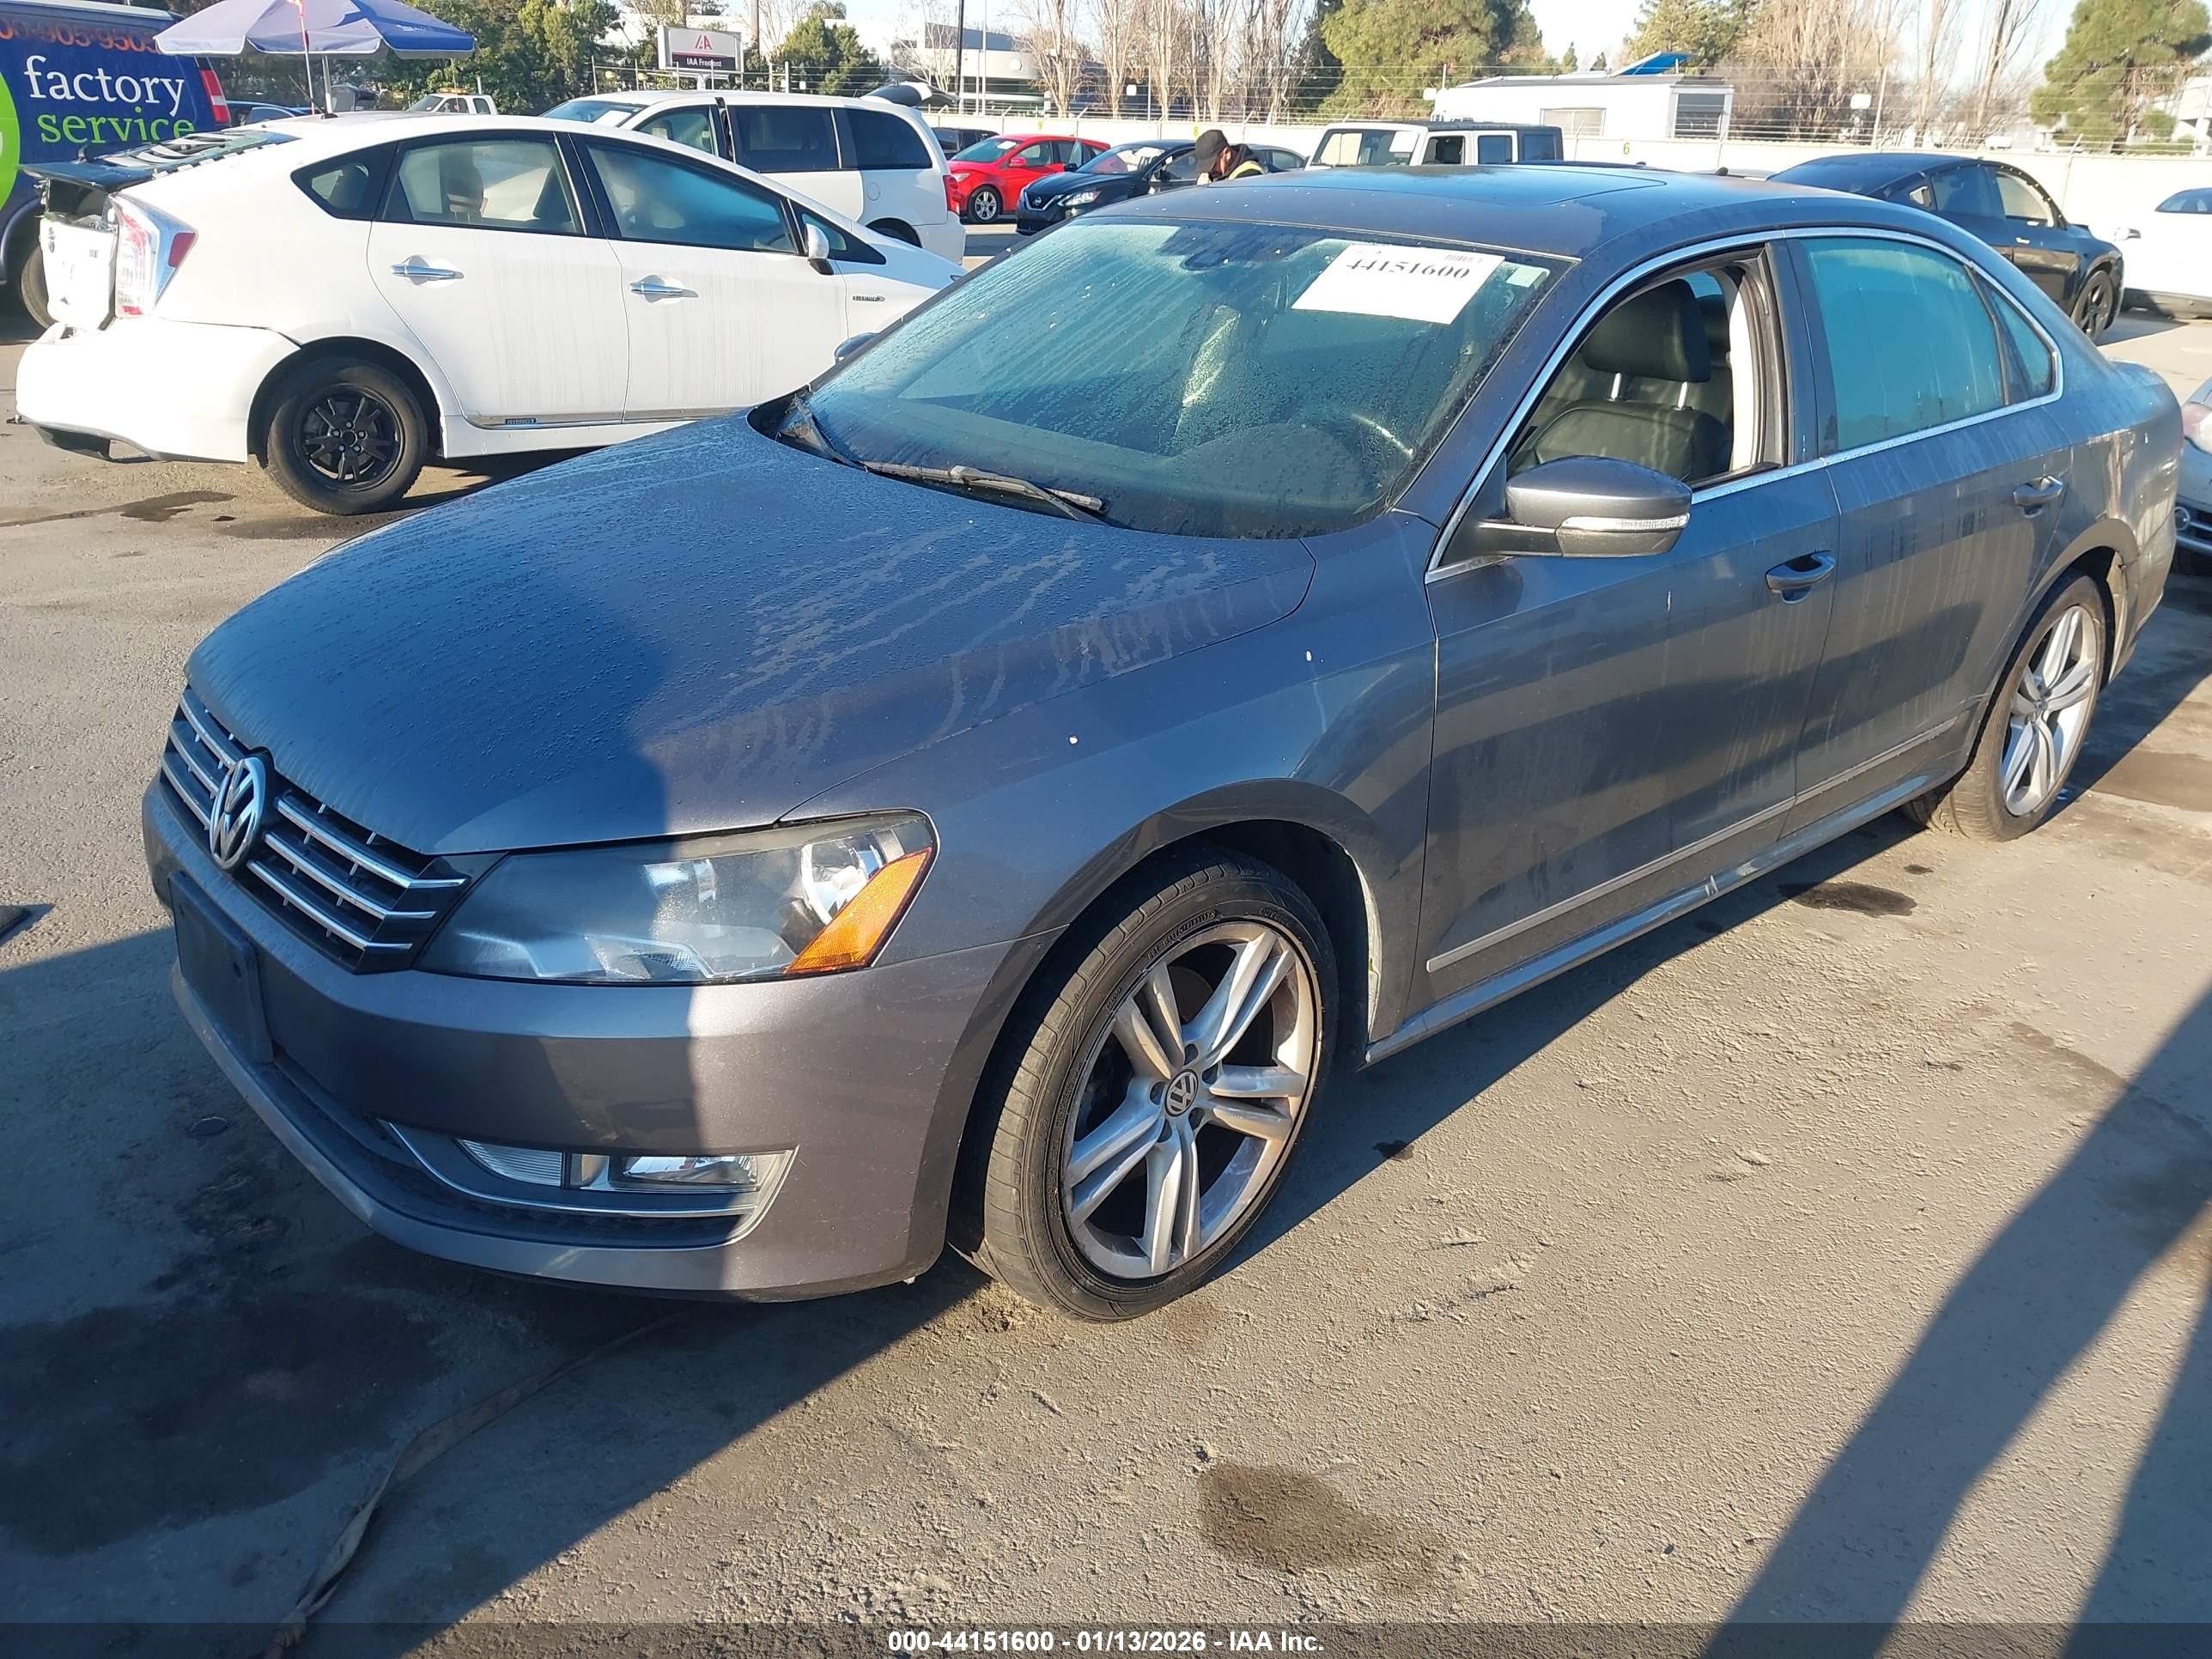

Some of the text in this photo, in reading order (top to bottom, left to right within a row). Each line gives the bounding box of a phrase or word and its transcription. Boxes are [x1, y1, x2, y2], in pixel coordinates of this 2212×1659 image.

[686, 57, 698, 66] IAA
[24, 55, 185, 117] factory
[37, 106, 195, 144] service
[1623, 142, 1630, 155] 6
[1346, 258, 1471, 279] 44151600
